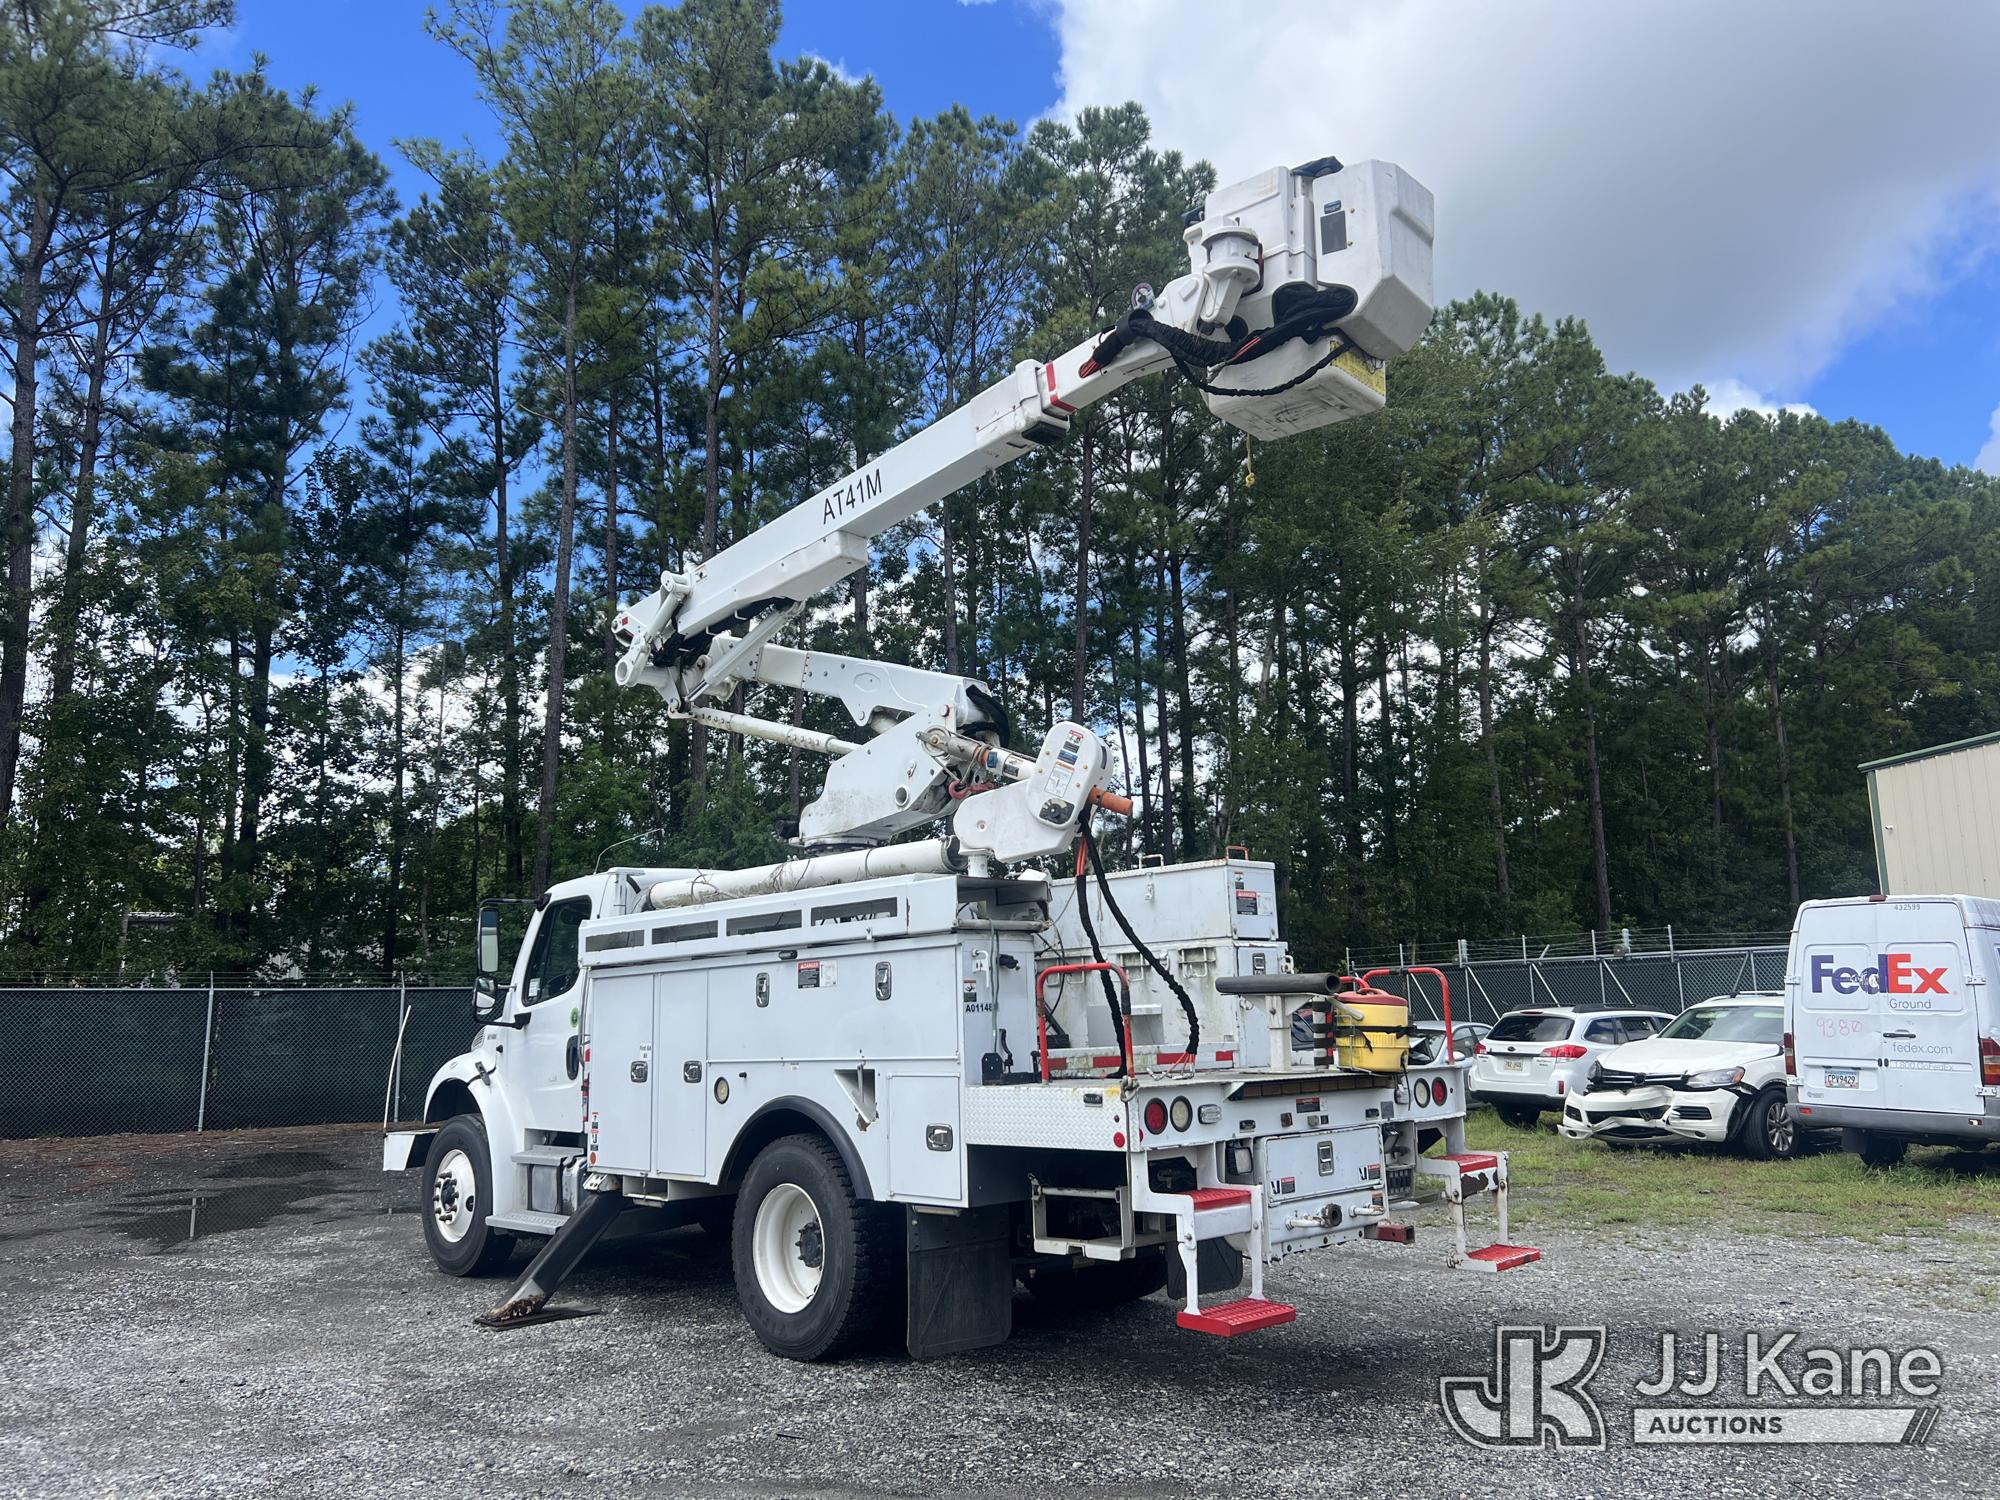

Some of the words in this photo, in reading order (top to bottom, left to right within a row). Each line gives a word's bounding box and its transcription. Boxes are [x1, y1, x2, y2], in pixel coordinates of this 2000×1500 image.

[823, 468, 882, 525] AT41M
[1811, 953, 1950, 995] FedEx
[1889, 999, 1932, 1009] Ground
[1892, 1042, 1953, 1054] fedex.com
[1827, 1074, 1856, 1085] CPV9429
